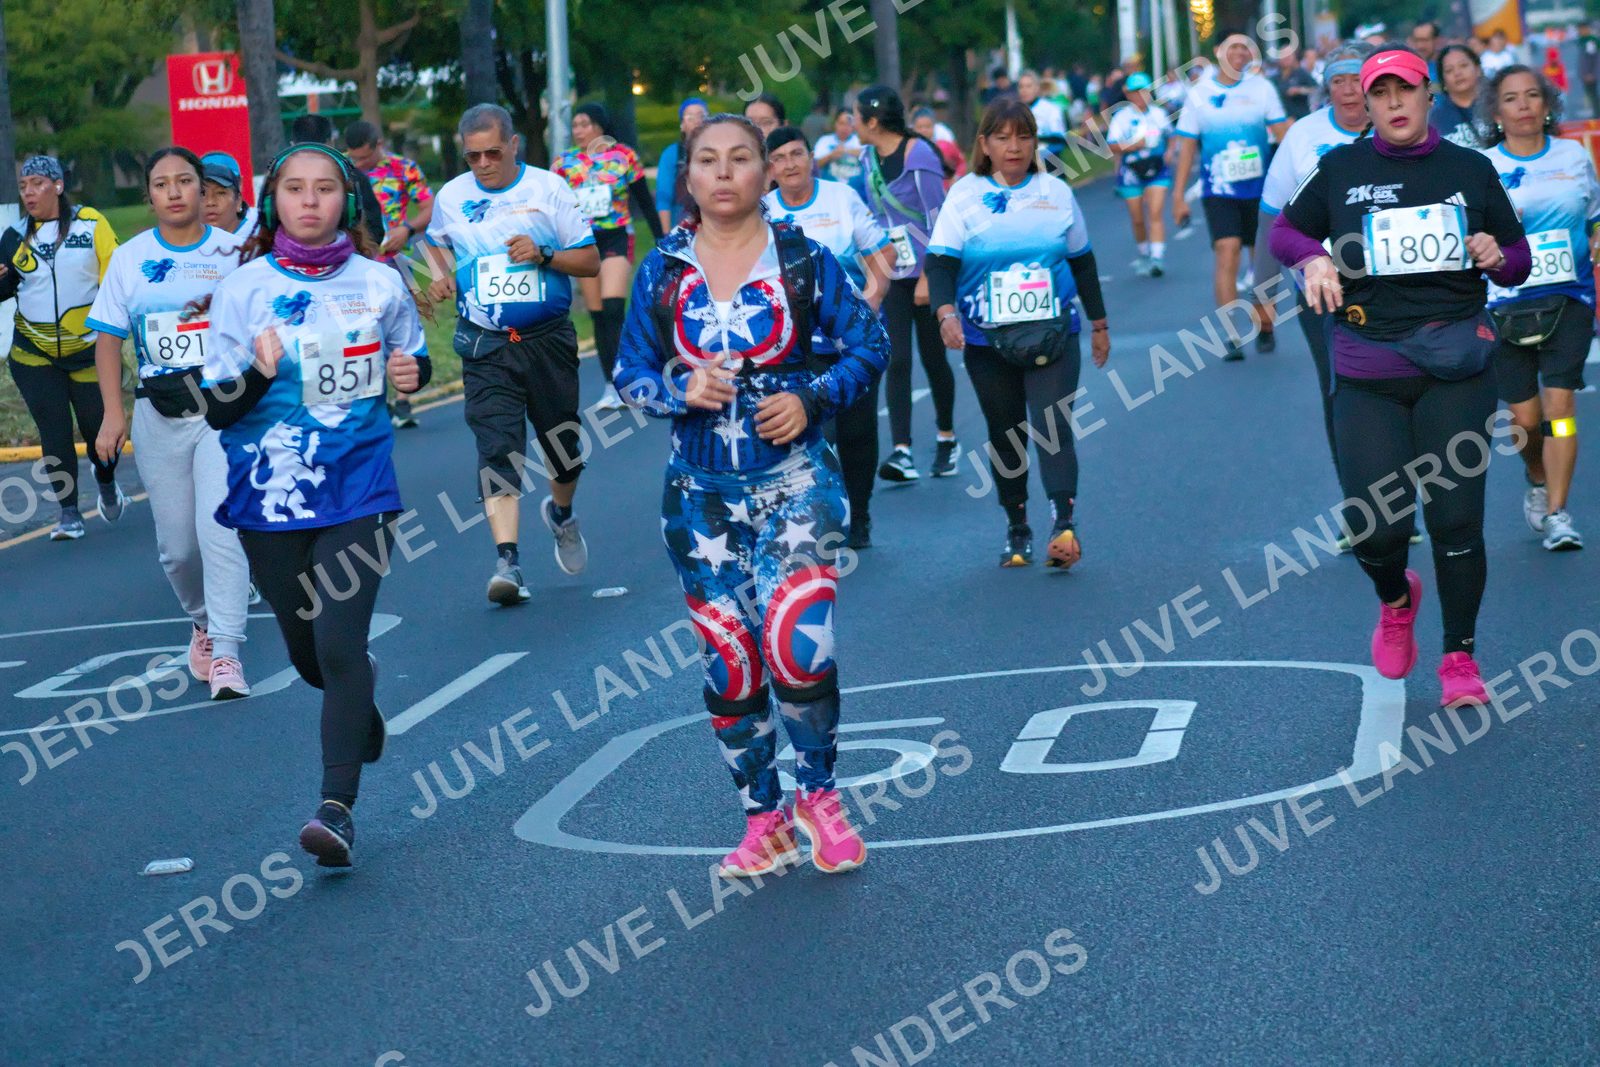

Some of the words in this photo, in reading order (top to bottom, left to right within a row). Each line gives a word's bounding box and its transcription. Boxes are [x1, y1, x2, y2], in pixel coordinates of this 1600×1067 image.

[178, 95, 248, 112] HONDA
[1380, 233, 1461, 266] 1802
[488, 275, 531, 298] 566
[995, 291, 1051, 315] 1004
[158, 333, 204, 360] 891
[319, 357, 372, 395] 851
